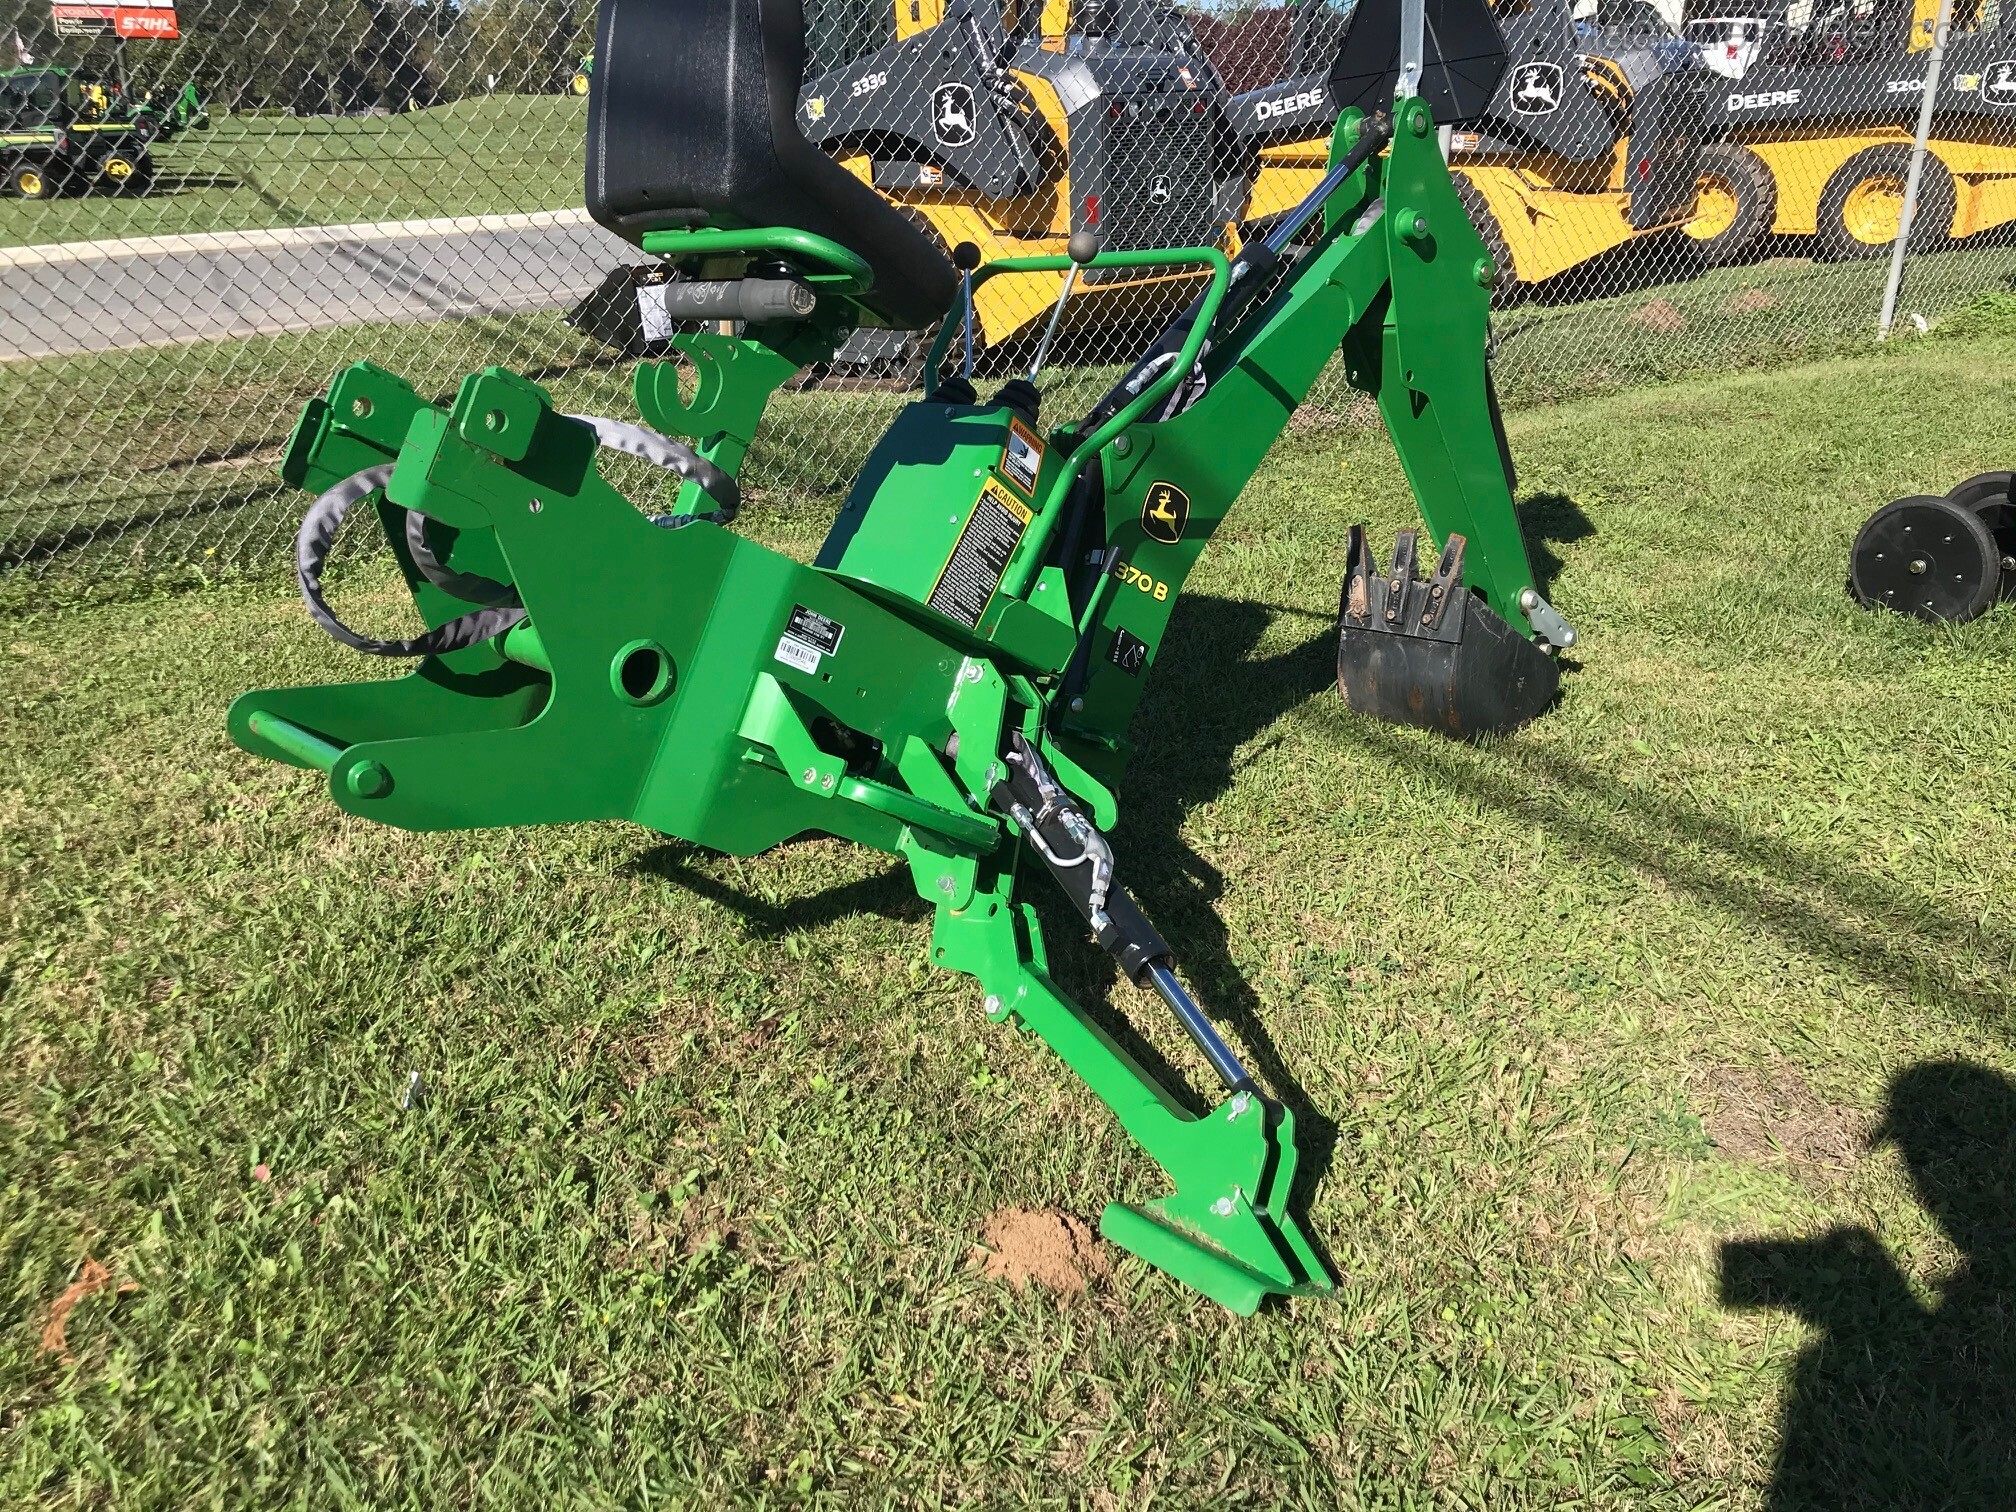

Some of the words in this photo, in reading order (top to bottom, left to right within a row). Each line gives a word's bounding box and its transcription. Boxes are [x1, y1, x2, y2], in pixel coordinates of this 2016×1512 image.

[59, 17, 84, 25] Power
[60, 26, 101, 35] Equipment
[122, 17, 173, 30] STIHL
[852, 71, 887, 97] 333G
[1256, 88, 1323, 121] DEERE
[1727, 88, 1801, 112] DEERE
[1018, 424, 1043, 455] WARNING
[998, 489, 1028, 520] CAUTION
[1114, 561, 1153, 593] 370
[1153, 581, 1169, 602] B
